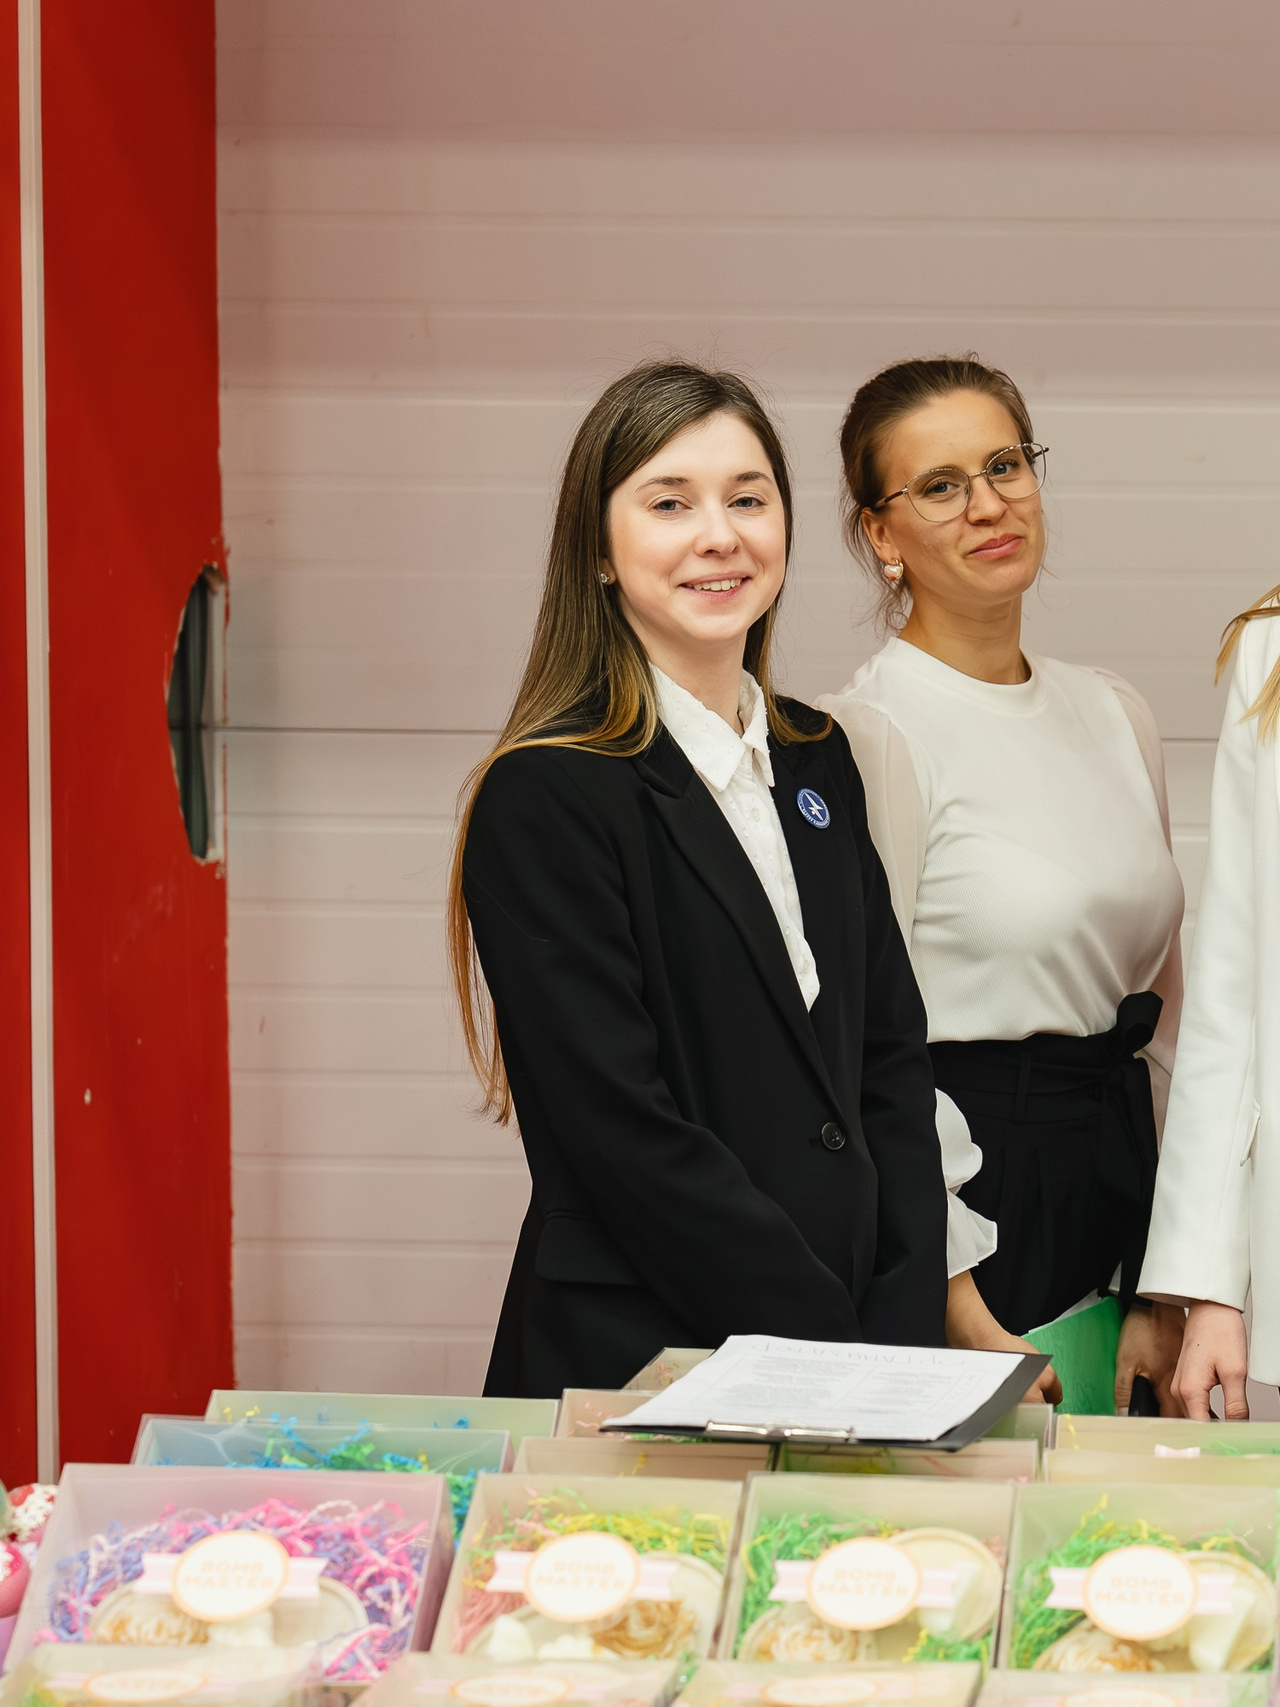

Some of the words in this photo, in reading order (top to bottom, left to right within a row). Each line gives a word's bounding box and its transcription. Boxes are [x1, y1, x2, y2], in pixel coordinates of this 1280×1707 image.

[201, 1560, 264, 1574] BOMB
[553, 1561, 615, 1575] BOMB
[835, 1568, 897, 1582] BOMB
[1110, 1576, 1173, 1589] BOMB
